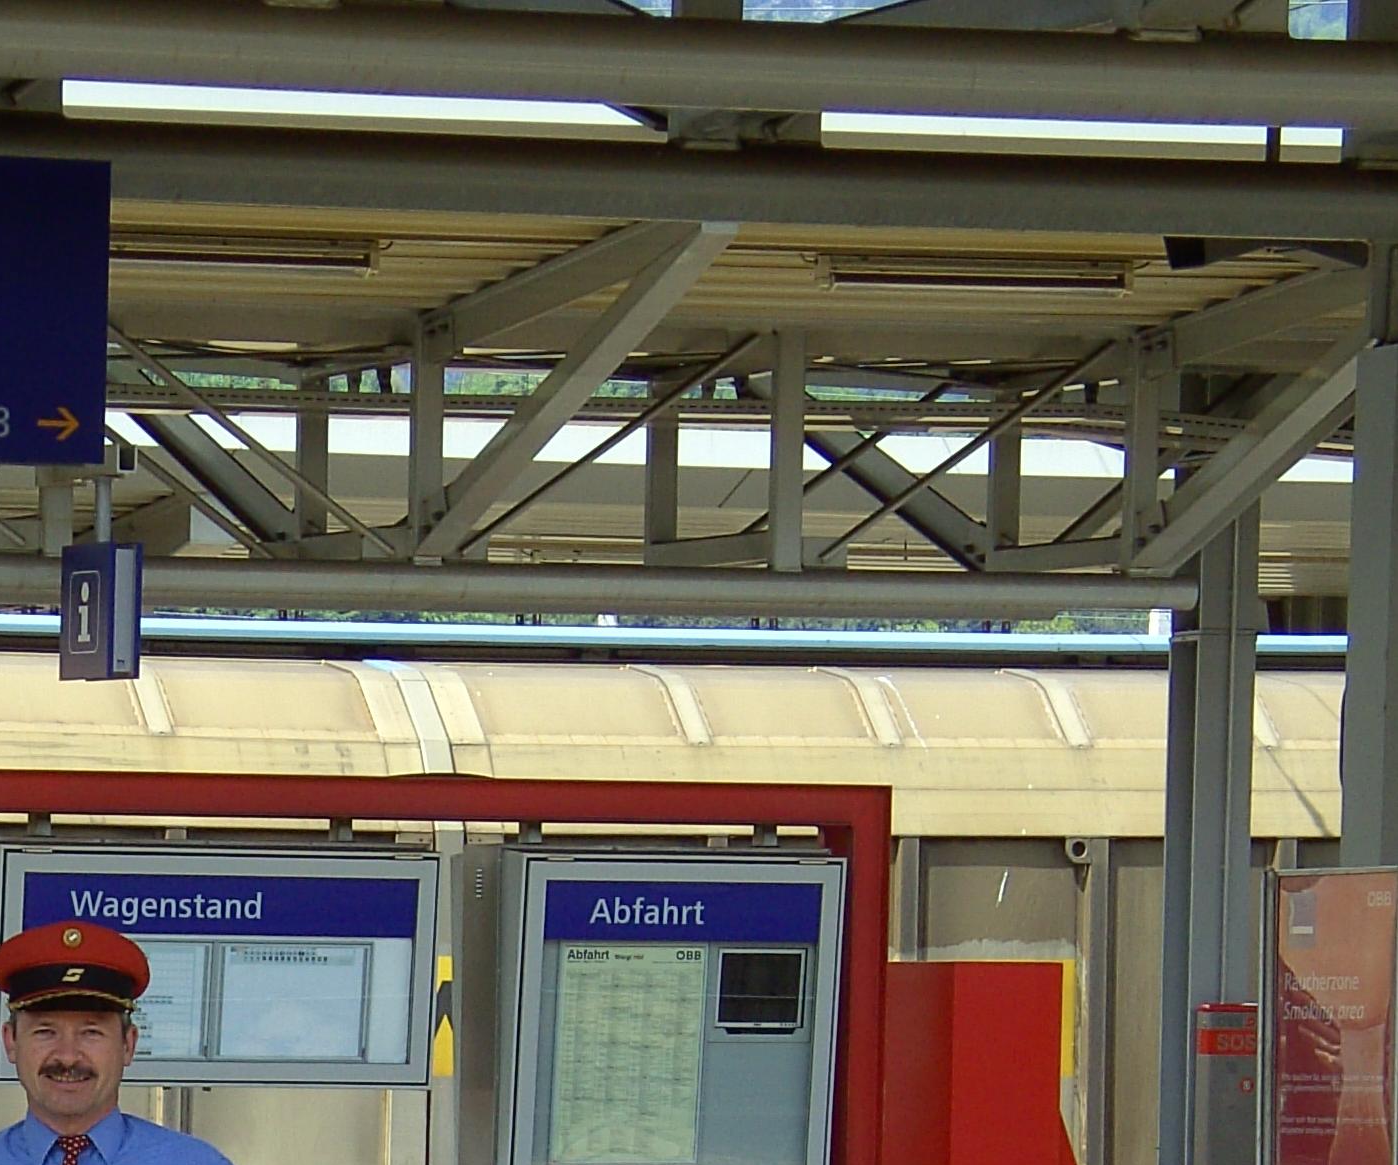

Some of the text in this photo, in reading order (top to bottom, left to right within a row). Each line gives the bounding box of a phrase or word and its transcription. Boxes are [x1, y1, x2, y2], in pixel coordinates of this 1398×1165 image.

[70, 890, 263, 925] Wagenstand
[589, 897, 705, 925] Abfahrt
[567, 949, 610, 960] Abfahrt
[1284, 970, 1360, 991] Raucherzone
[1283, 1001, 1365, 1025] Smoking area
[1217, 1034, 1257, 1052] SOS
